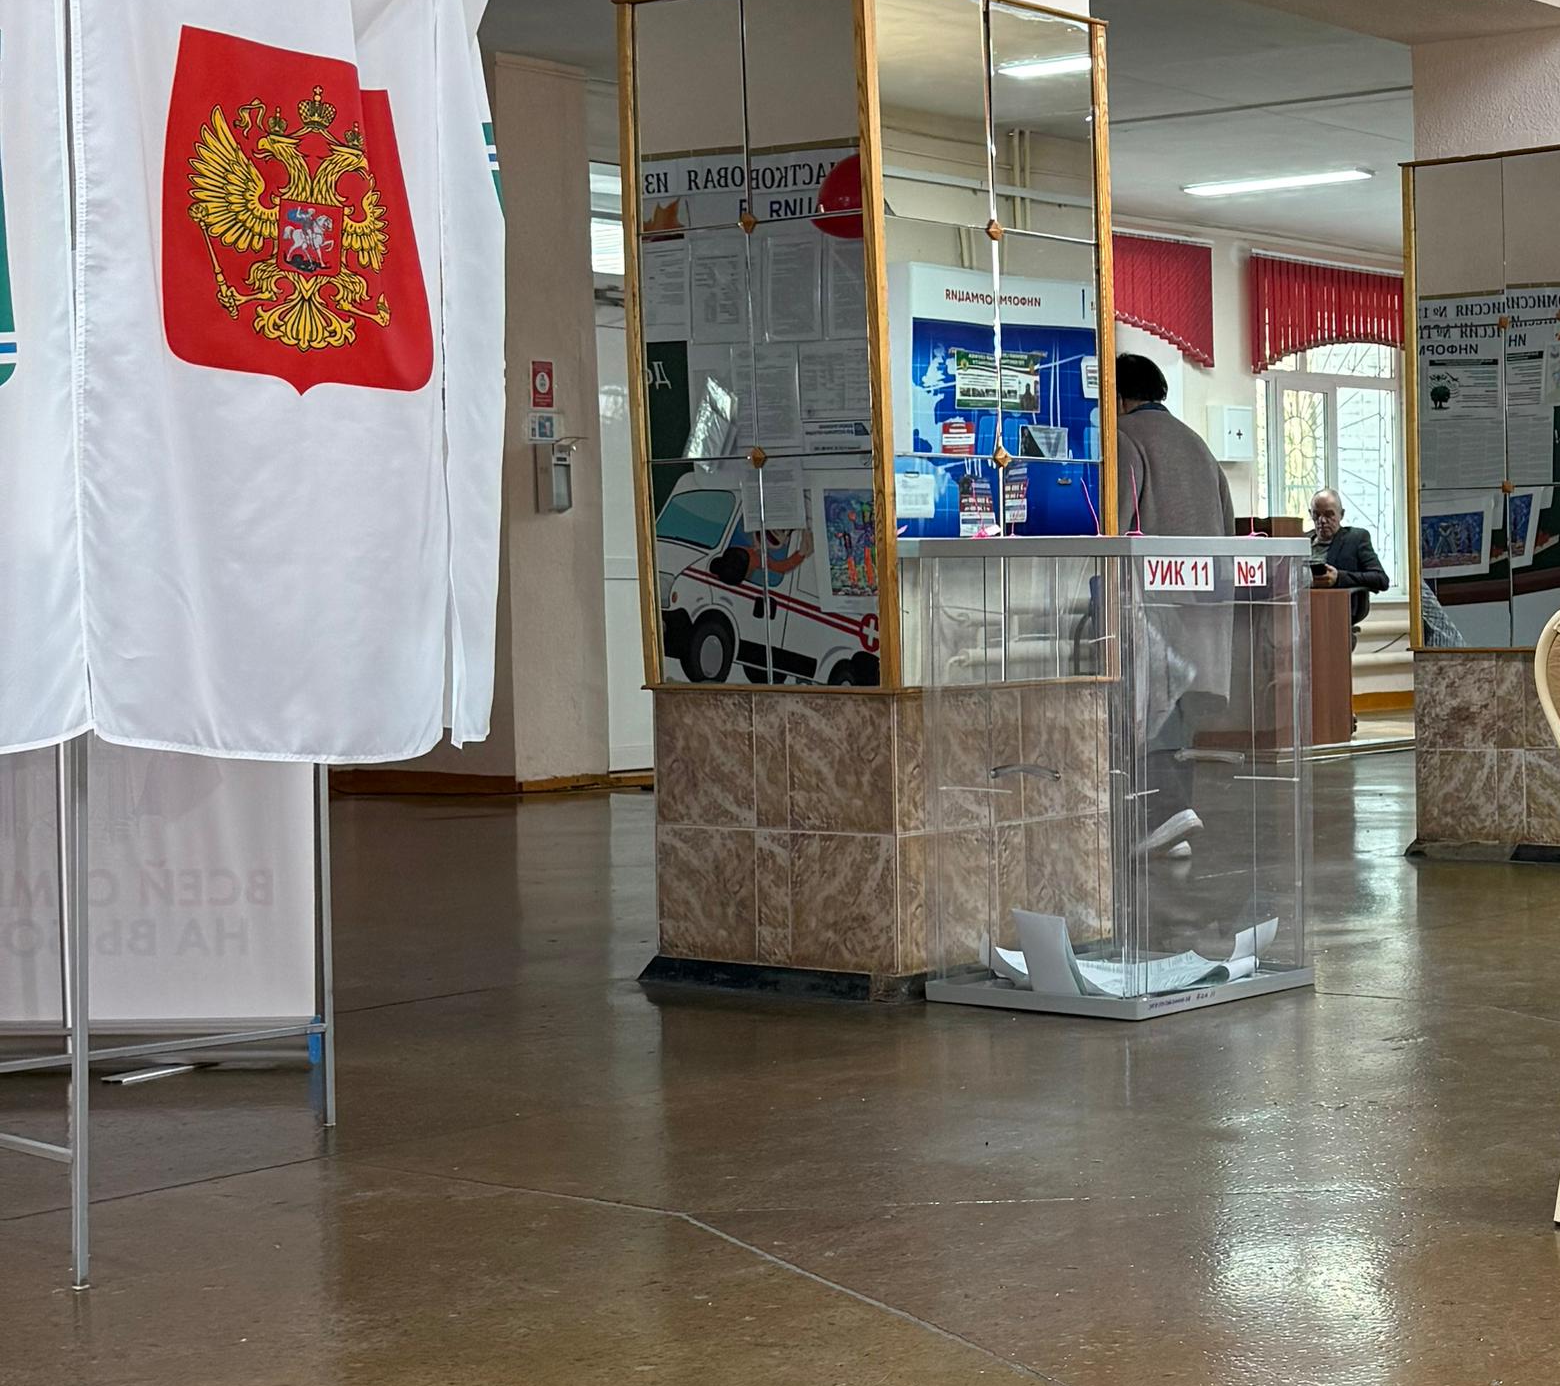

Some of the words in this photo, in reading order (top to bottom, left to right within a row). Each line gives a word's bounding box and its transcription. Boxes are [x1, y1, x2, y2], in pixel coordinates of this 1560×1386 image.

[1148, 560, 1185, 586] УИК
[1191, 560, 1209, 586] 11
[1237, 560, 1264, 584] №1
